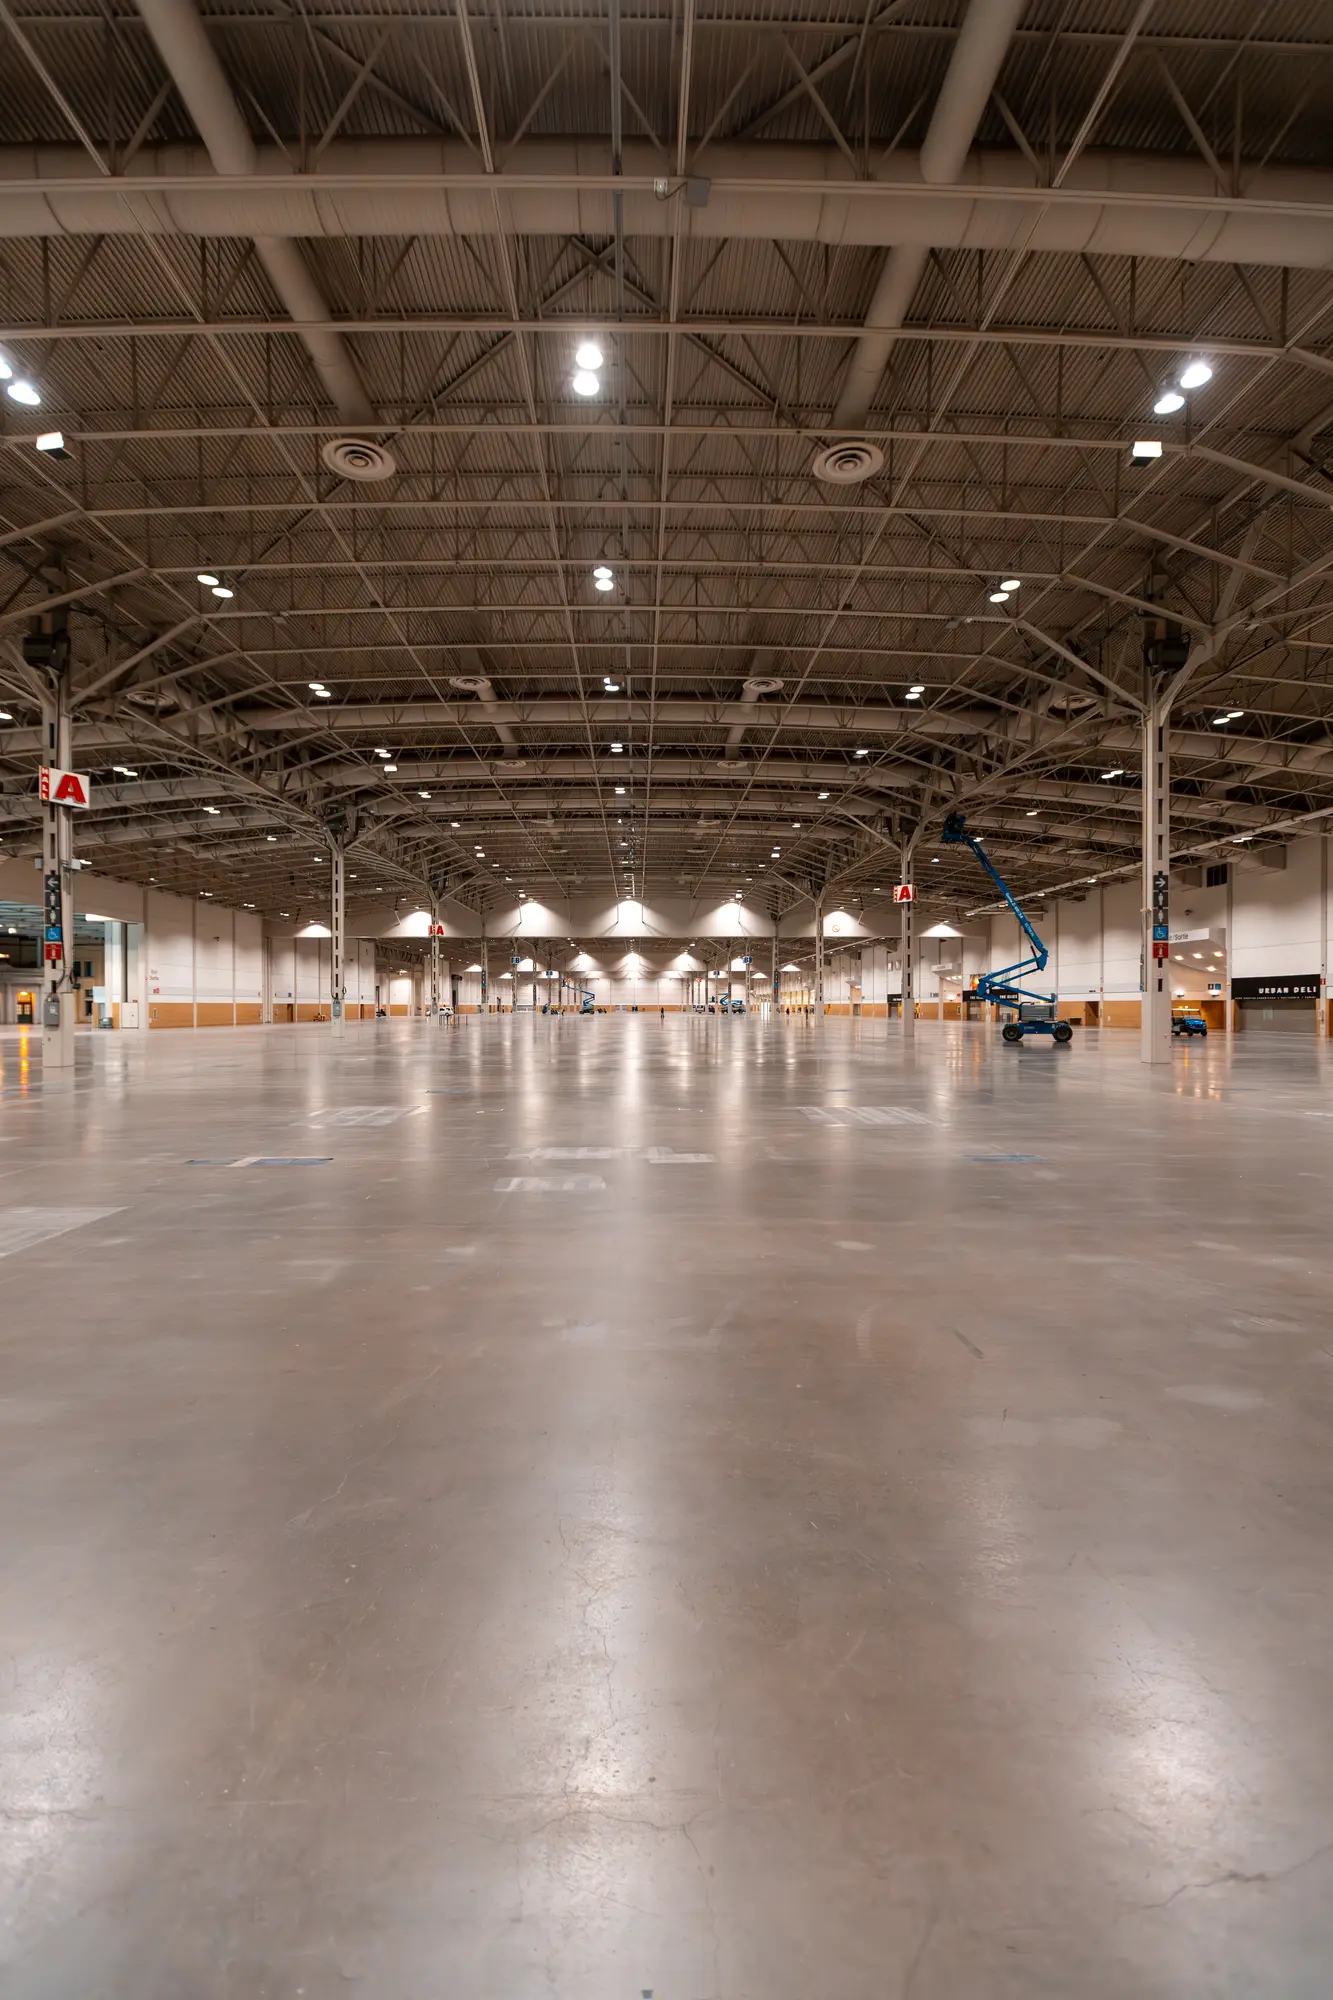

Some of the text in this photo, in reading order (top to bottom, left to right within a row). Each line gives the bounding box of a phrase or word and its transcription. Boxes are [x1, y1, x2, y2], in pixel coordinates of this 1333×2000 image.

[41, 767, 49, 800] HALL
[54, 774, 87, 804] A
[899, 886, 911, 900] A
[437, 925, 444, 935] A
